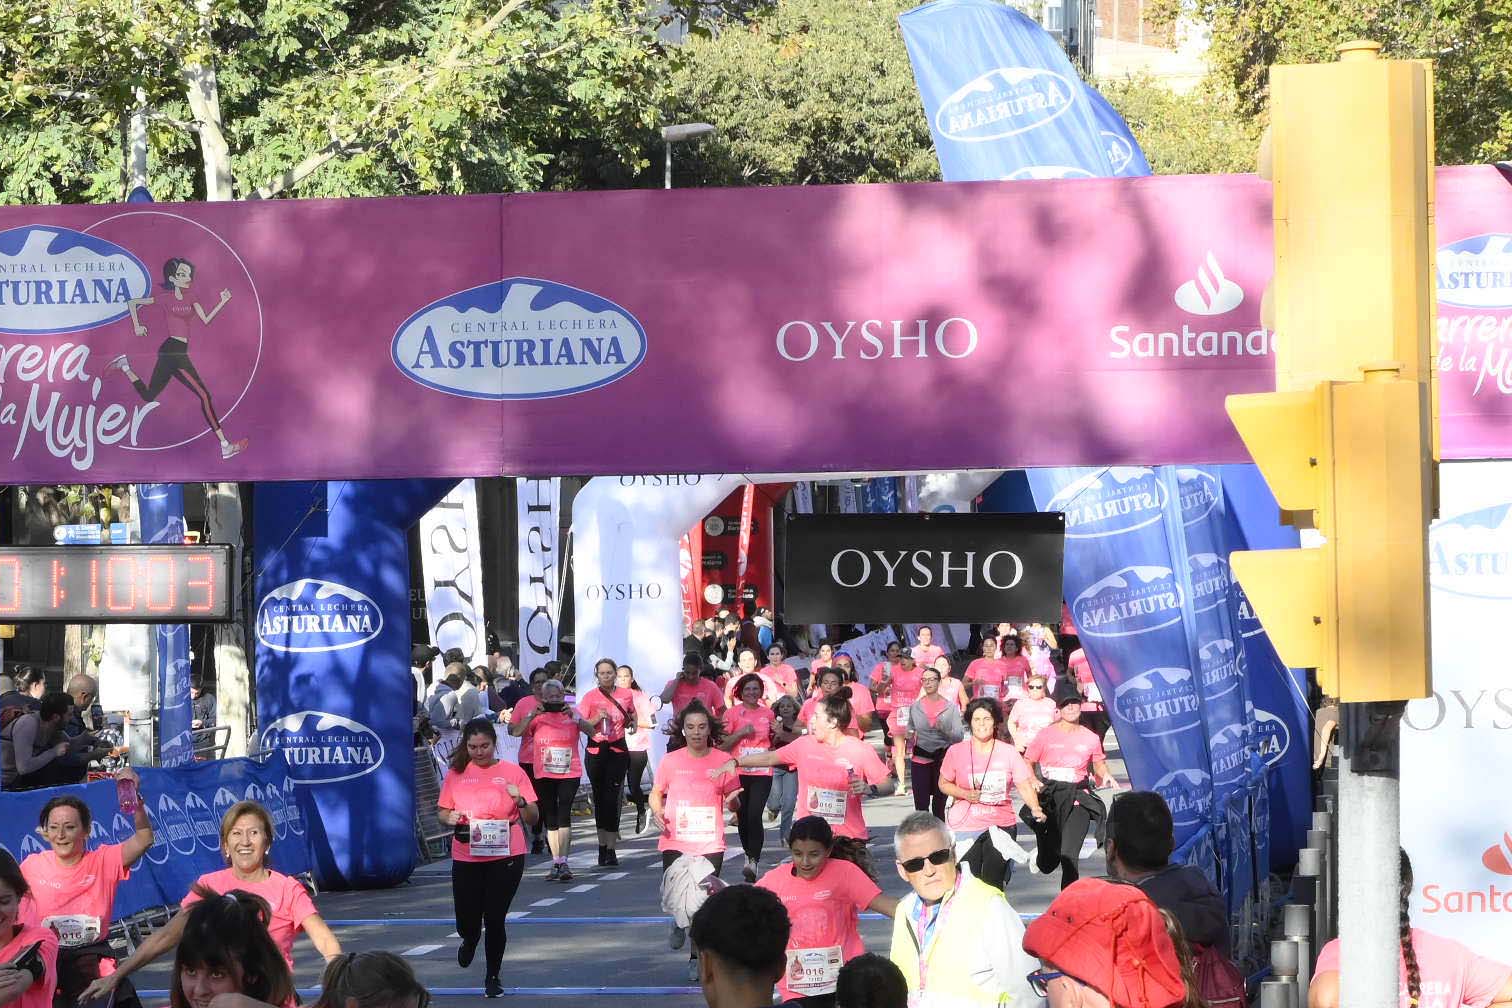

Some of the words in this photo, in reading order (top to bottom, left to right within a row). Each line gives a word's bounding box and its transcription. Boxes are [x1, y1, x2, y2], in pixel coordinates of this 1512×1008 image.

[54, 261, 126, 272] LECHERA
[451, 320, 528, 333] CENTRAL
[538, 318, 618, 330] LECHERA
[412, 325, 626, 370] ASTURIANA
[776, 316, 977, 362] OYSHO
[13, 376, 160, 471] Mujer
[831, 548, 1024, 590] OYSHO
[586, 583, 662, 600] OYSHO
[273, 603, 316, 613] CENTRAL
[320, 602, 370, 612] LECHERA
[261, 609, 375, 635] ASTURIANA
[321, 734, 370, 744] LECHERA
[283, 745, 375, 766] TURIANA
